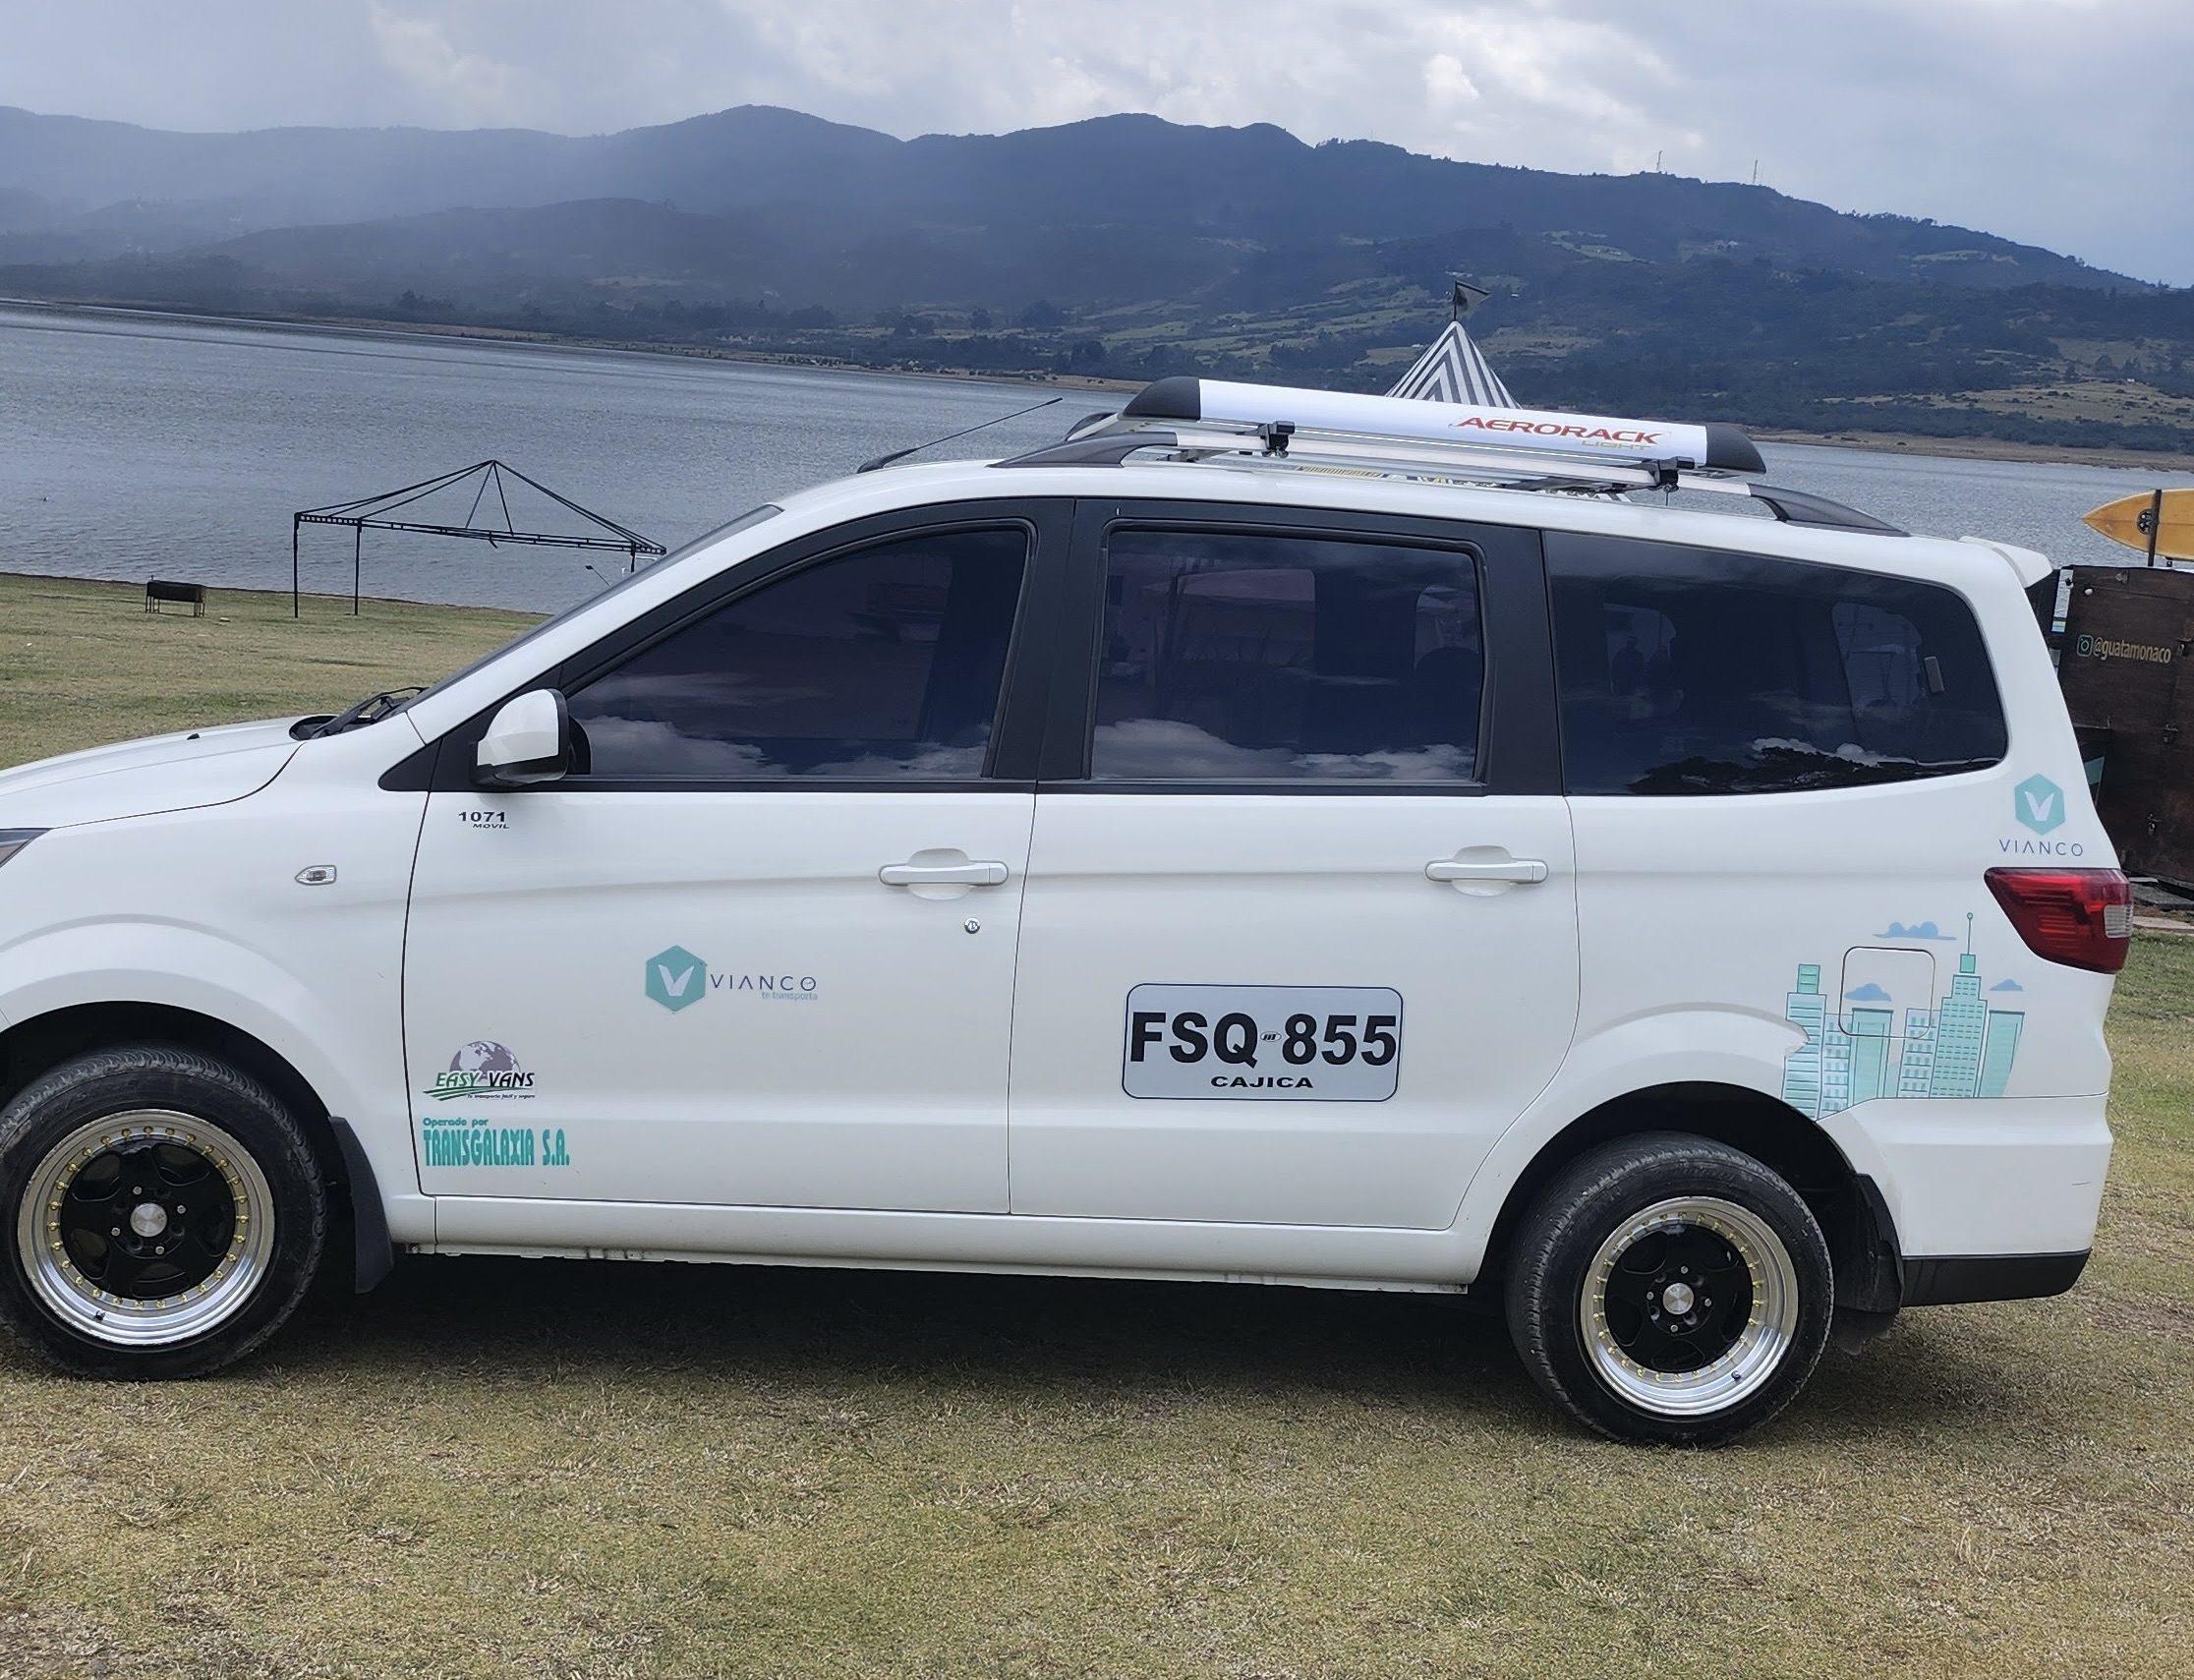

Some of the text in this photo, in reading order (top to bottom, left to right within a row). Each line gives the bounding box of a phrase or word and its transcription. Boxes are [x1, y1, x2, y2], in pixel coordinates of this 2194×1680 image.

[1456, 417, 1663, 445] AERORACK
[1581, 439, 1652, 451] LIGHT
[2093, 636, 2172, 664] @guatamonaco
[458, 811, 505, 823] 1071
[1998, 839, 2084, 857] VIANCO
[710, 973, 817, 992] VIANCO
[1129, 1011, 1397, 1070] FSQ 855
[435, 1072, 535, 1088] EASY VANS
[1210, 1075, 1314, 1089] CAJICA
[423, 1117, 490, 1129] Operado por
[423, 1129, 570, 1167] TRANSGALAXIA S.A.
